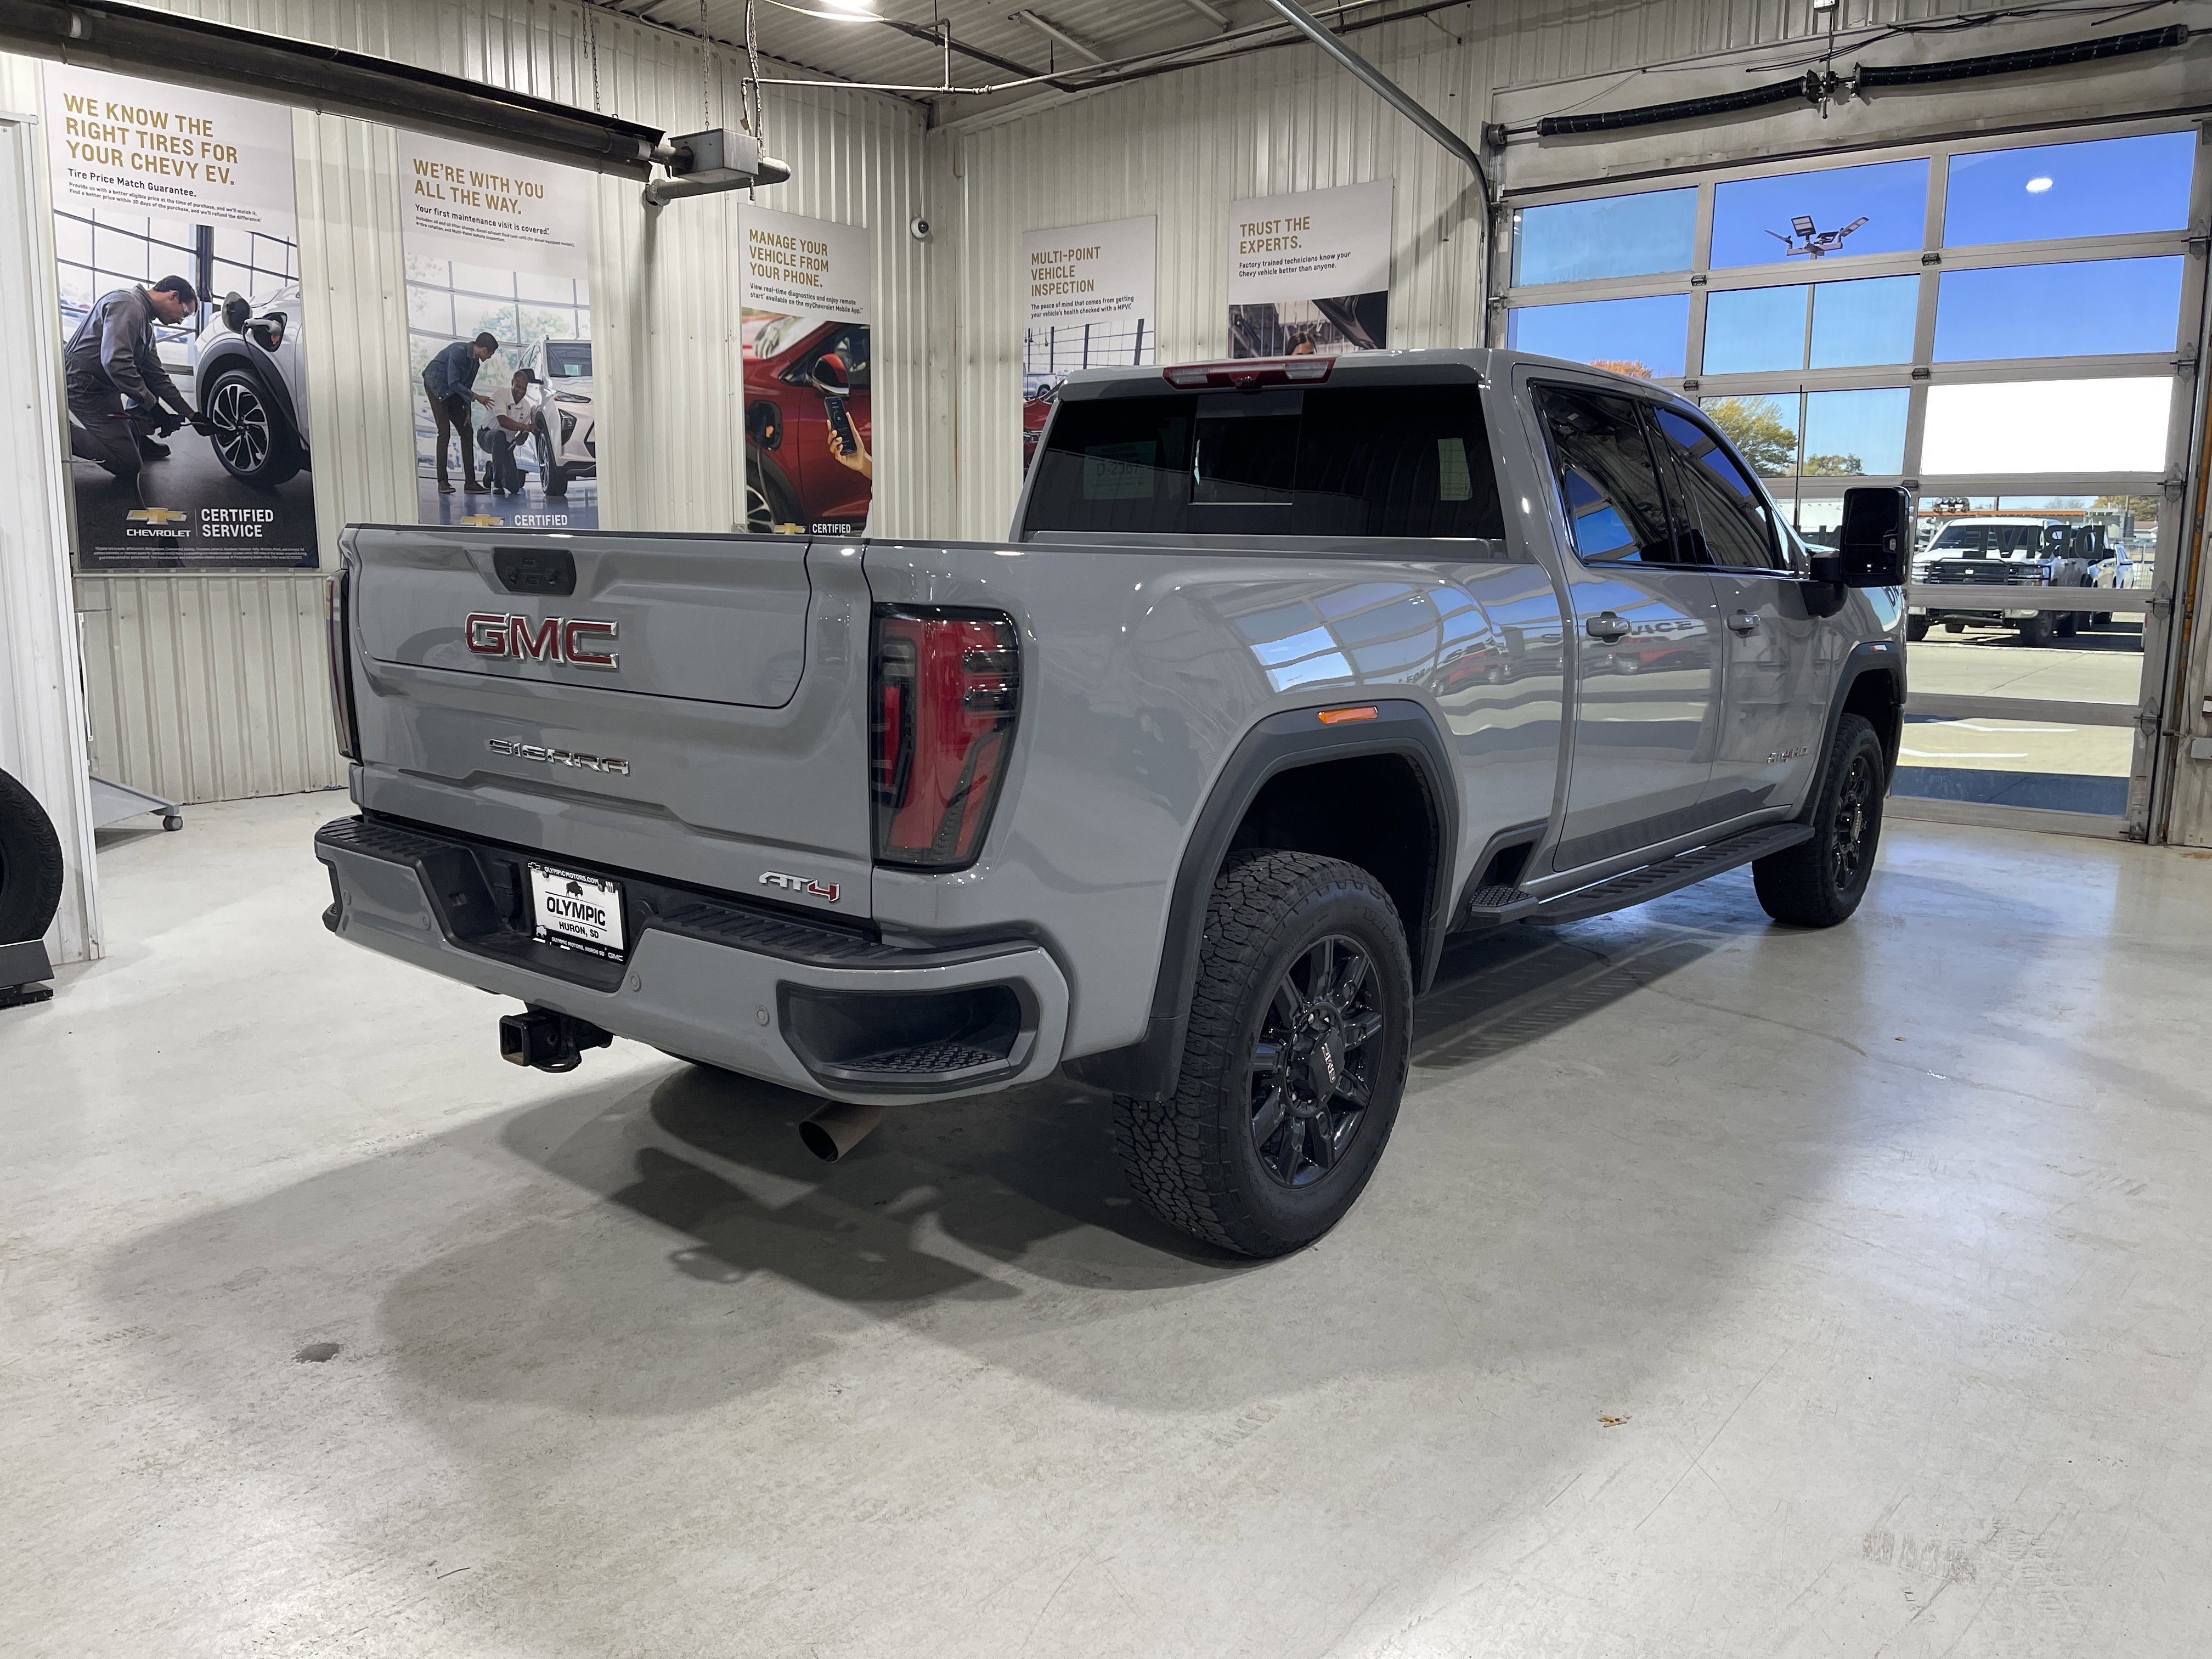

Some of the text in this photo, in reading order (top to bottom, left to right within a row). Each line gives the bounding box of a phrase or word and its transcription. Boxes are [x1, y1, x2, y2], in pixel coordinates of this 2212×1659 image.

[64, 93, 213, 138] WE KNOW THE
[66, 117, 238, 164] RIGHT TIRES FOR
[66, 140, 235, 185] YOUR CHEVY EV.
[68, 168, 196, 197] Tire Price Match Guarantee.
[413, 159, 544, 199] WE'RE WITH YOU
[415, 180, 521, 215] ALL THE WAY.
[415, 204, 432, 213] Your
[434, 208, 450, 218] first
[452, 213, 496, 227] maintenance
[498, 221, 512, 230] visit
[1240, 216, 1310, 237] TRUST THE
[749, 228, 828, 256] MANAGE YOUR
[1240, 235, 1302, 254] EXPERTS.
[749, 245, 828, 273] VEHICLE FROM
[1031, 246, 1101, 265] MULTI-POINT
[1284, 256, 1318, 264] technicians
[749, 262, 823, 288] YOUR PHONE.
[1031, 265, 1075, 281] VEHICLE
[1313, 263, 1336, 271] anyone.
[750, 283, 762, 291] View
[763, 286, 787, 296] real-time
[788, 290, 815, 300] diagnostics
[826, 297, 839, 305] enjoy
[1031, 279, 1094, 297] INSPECTION
[766, 295, 787, 304] available
[805, 302, 834, 311] myChevrolet
[1116, 296, 1134, 304] getting
[201, 508, 274, 523] CERTIFIED
[514, 514, 568, 527] CERTIFIED
[126, 528, 191, 538] CHEVROLET
[202, 524, 263, 538] SERVICE
[812, 523, 851, 533] CERTIFIED
[465, 611, 620, 669] GMC
[489, 738, 630, 776] SIERRA
[759, 871, 840, 903] AT4
[547, 896, 606, 927] OLYMPIC
[559, 921, 599, 939] HURON, SD
[608, 952, 623, 962] GMC
[1321, 1042, 1336, 1084] GMC
